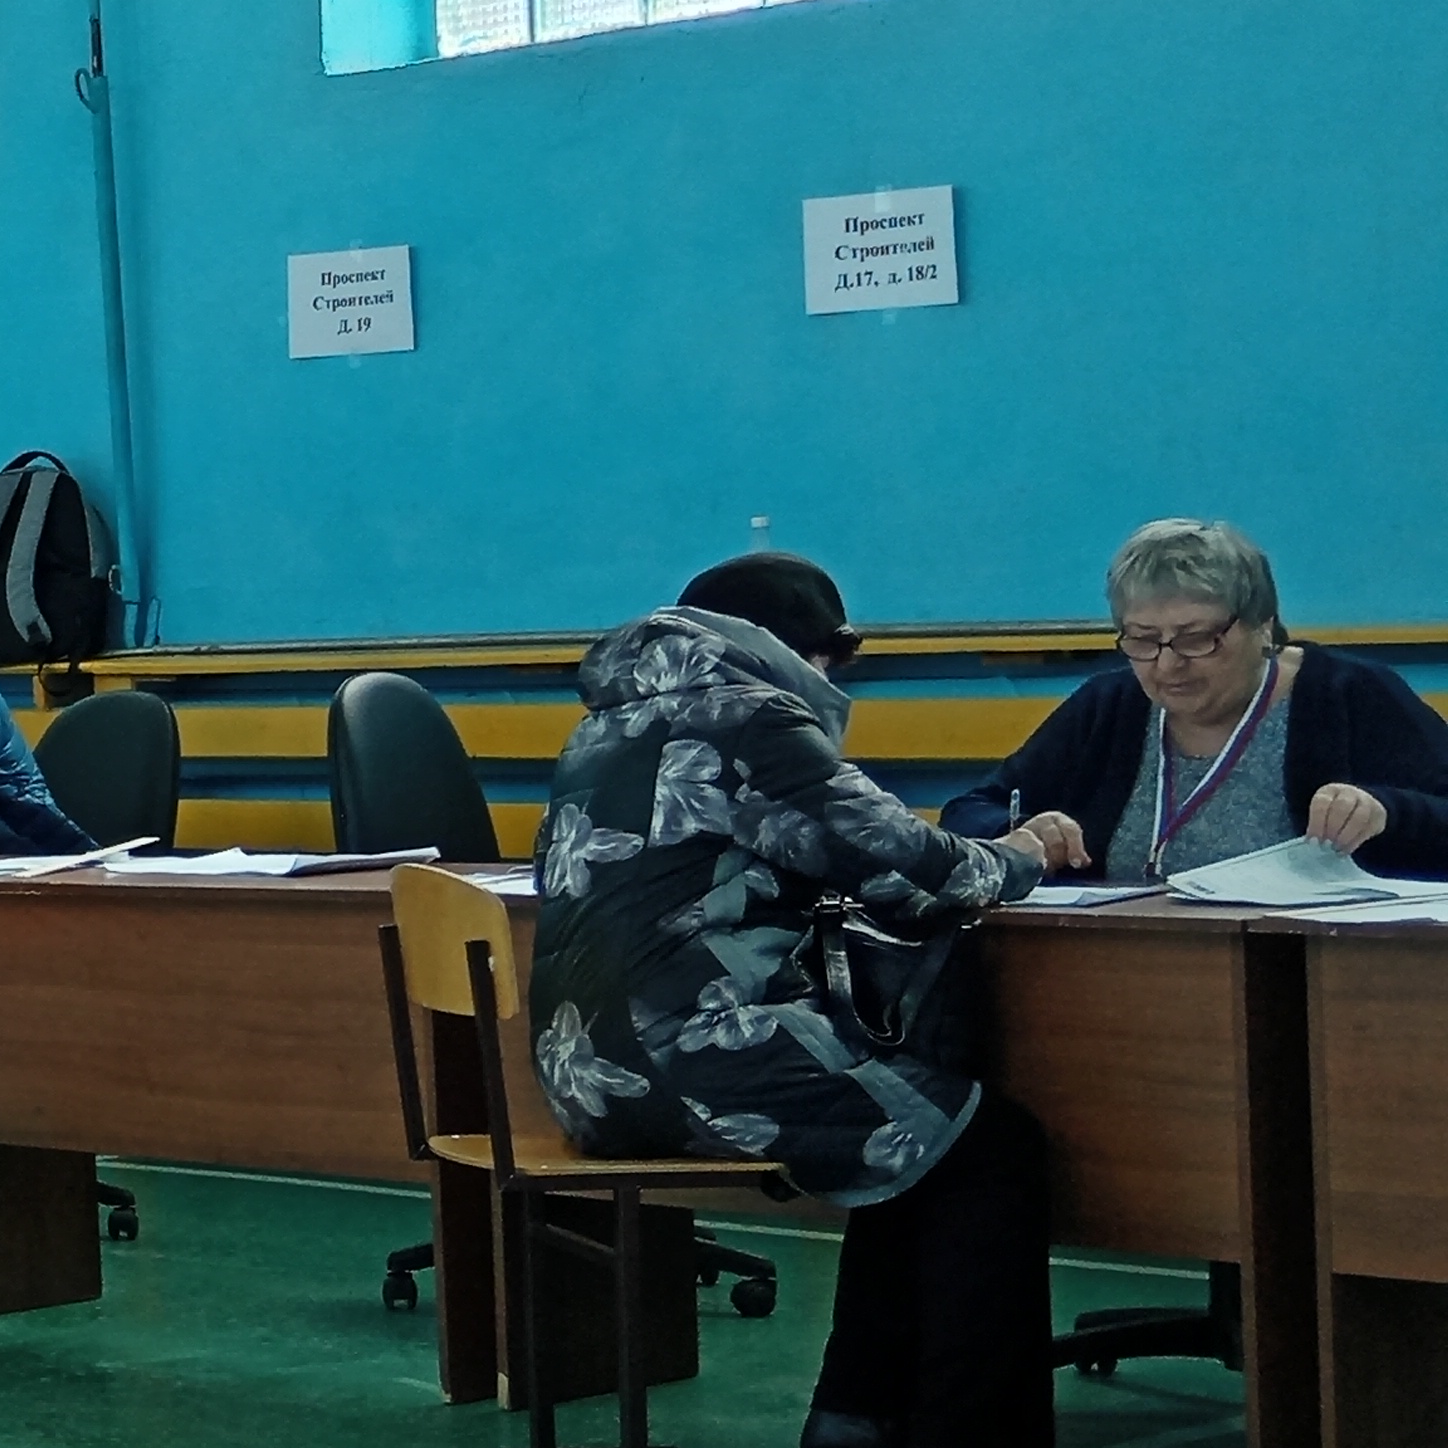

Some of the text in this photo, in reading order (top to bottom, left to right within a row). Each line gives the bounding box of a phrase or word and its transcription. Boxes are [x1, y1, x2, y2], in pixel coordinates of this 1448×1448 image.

[844, 213, 925, 236] Проспект
[834, 236, 936, 262] Строителей
[321, 269, 385, 288] Проспект
[907, 264, 938, 283] 18/2
[312, 290, 394, 312] Строителей
[357, 317, 372, 332] 19
